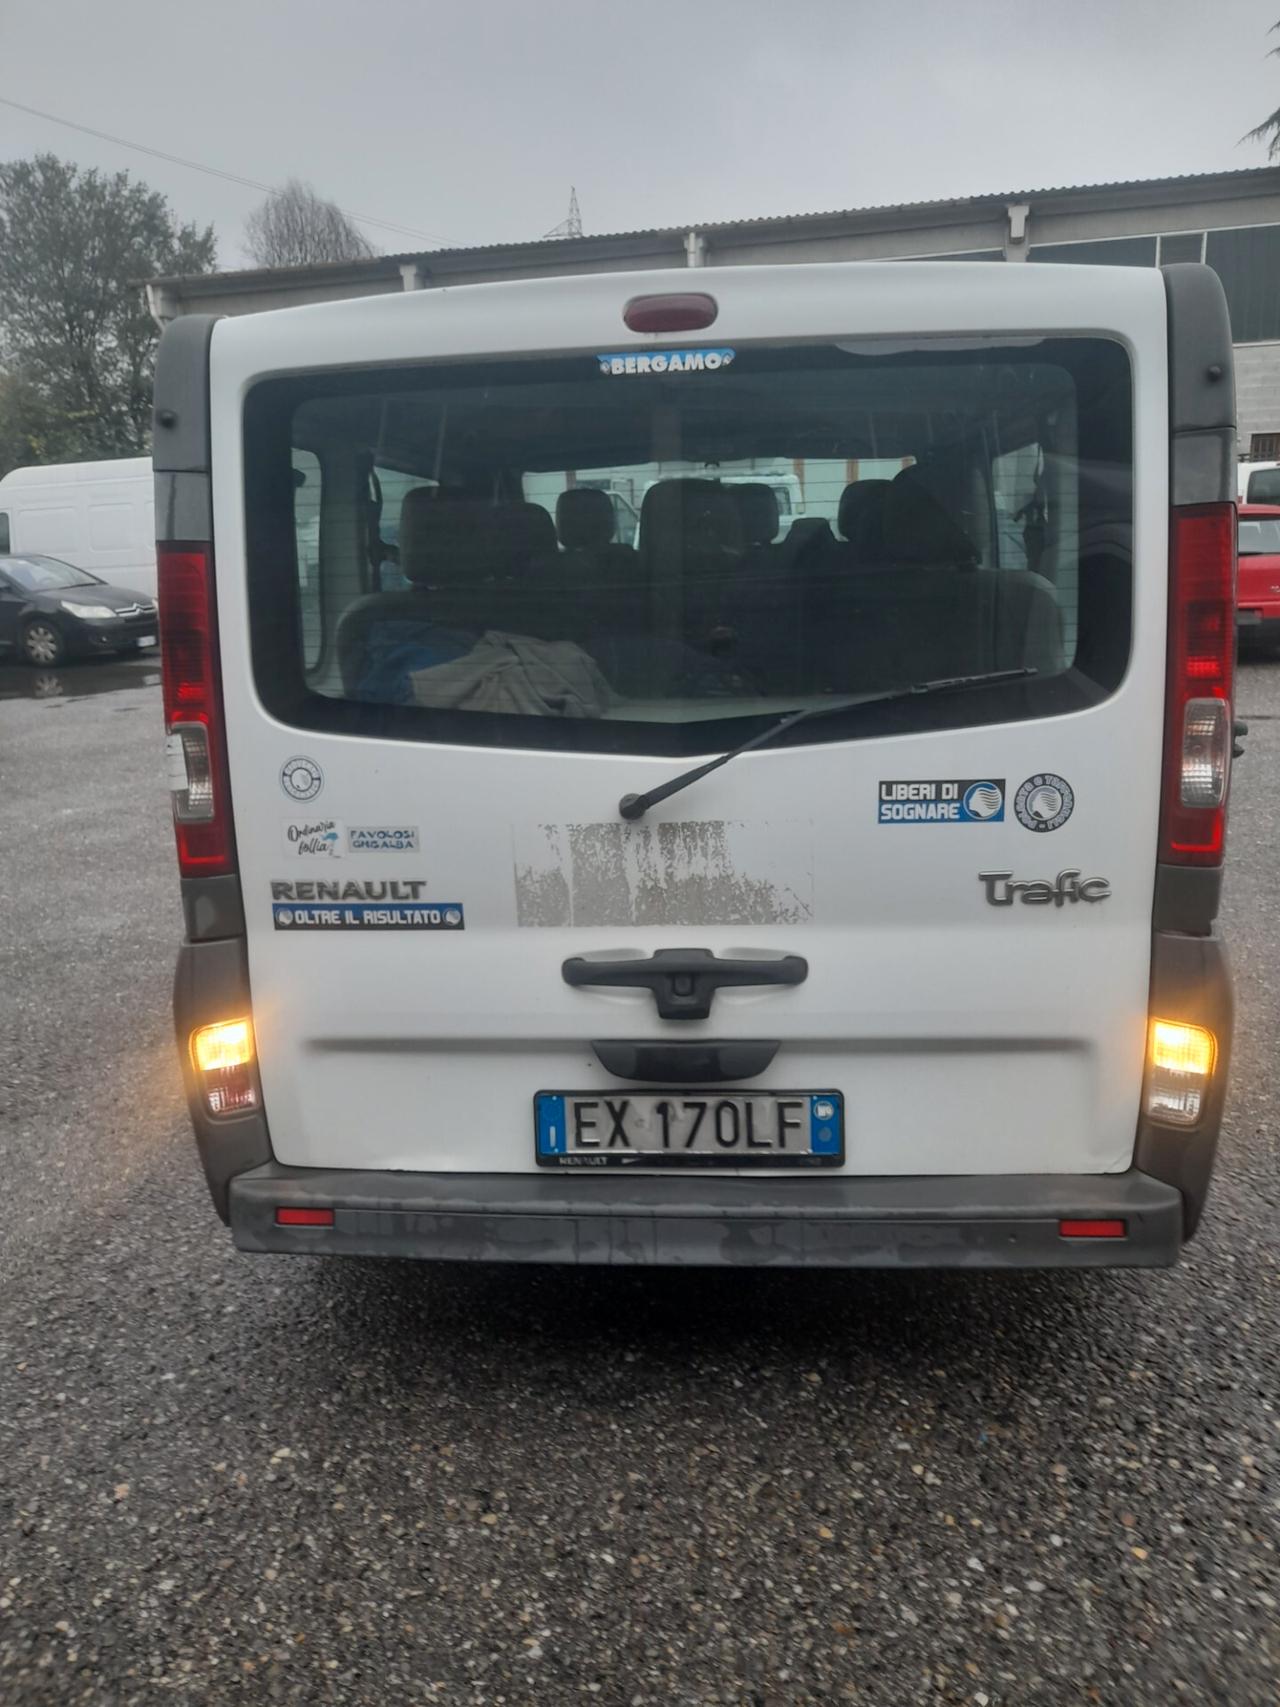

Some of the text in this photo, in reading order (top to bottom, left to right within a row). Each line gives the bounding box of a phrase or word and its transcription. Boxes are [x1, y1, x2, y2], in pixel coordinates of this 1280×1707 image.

[610, 352, 722, 375] BERGAMO
[881, 784, 958, 800] LIBERI DI
[880, 803, 960, 820] SOGNARE
[270, 881, 427, 900] RENAULT
[978, 868, 1112, 908] Trafic
[294, 910, 441, 925] OLTRE IL RISULTATO
[573, 1100, 803, 1148] EX 170LF
